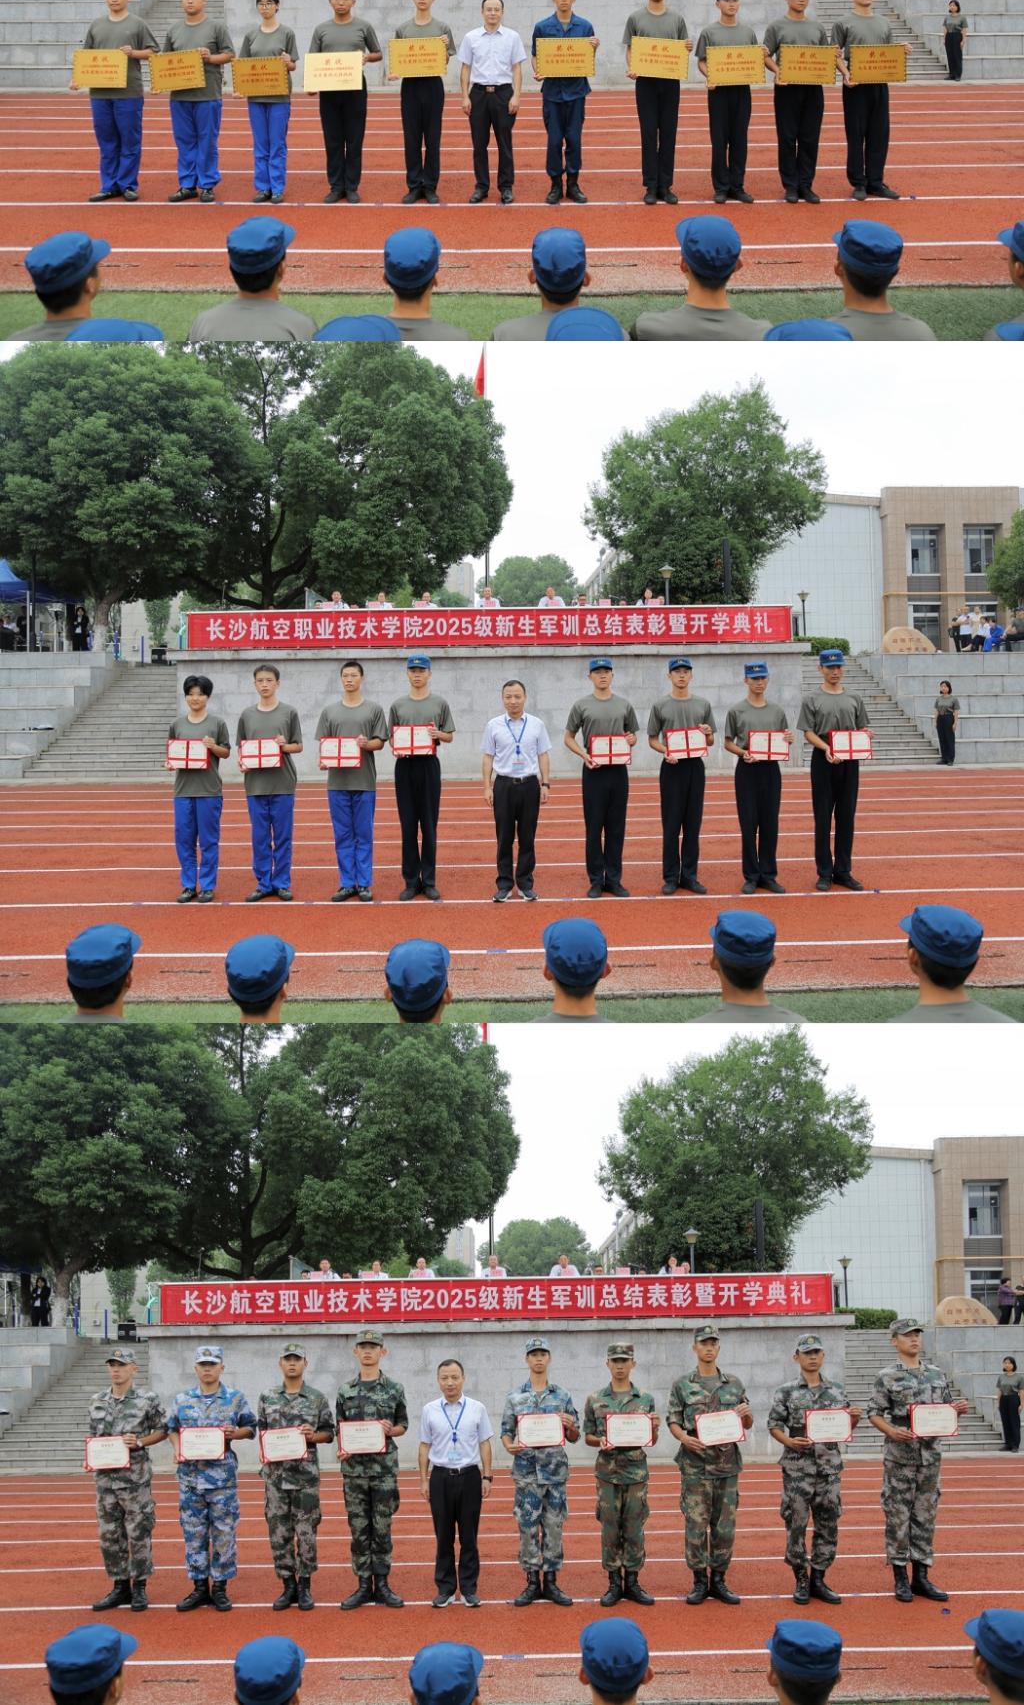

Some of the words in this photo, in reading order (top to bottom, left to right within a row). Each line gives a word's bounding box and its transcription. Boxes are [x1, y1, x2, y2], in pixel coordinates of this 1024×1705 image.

[206, 610, 773, 642] 长沙航空职业技术学院2025级新生军训总结表彰暨开学典礼
[180, 1279, 812, 1314] 长沙航空职业技术学院2025级新生军训总结表彰暨开学典礼
